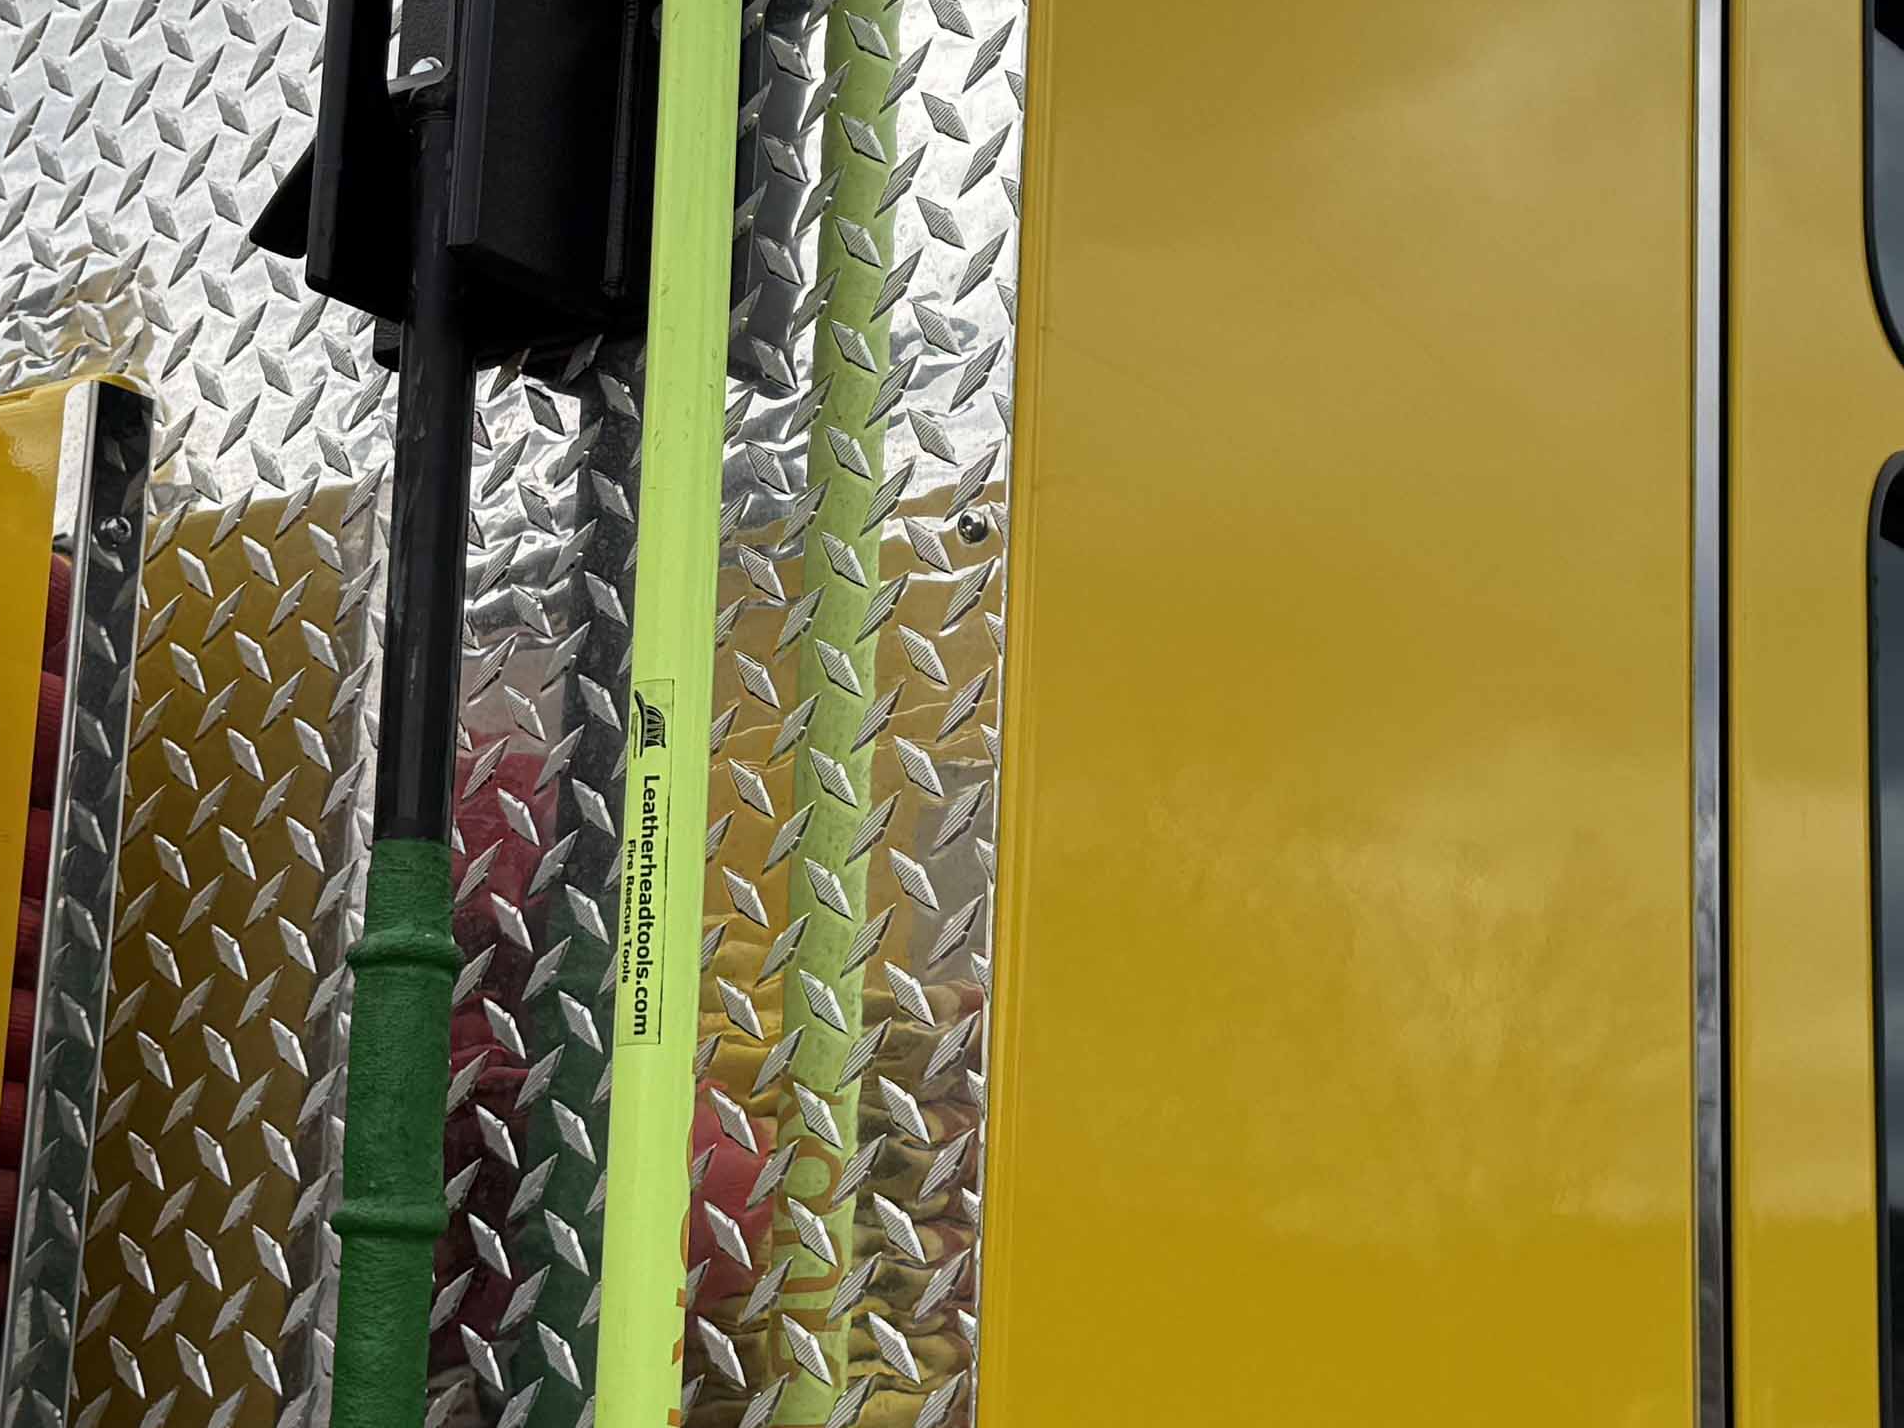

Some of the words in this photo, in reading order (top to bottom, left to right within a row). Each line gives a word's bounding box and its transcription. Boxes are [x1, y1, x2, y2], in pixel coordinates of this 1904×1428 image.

[627, 838, 637, 870] Fire
[623, 875, 635, 940] Rescue
[632, 773, 661, 1037] Leatherheadtools.com
[620, 941, 632, 984] Tools
